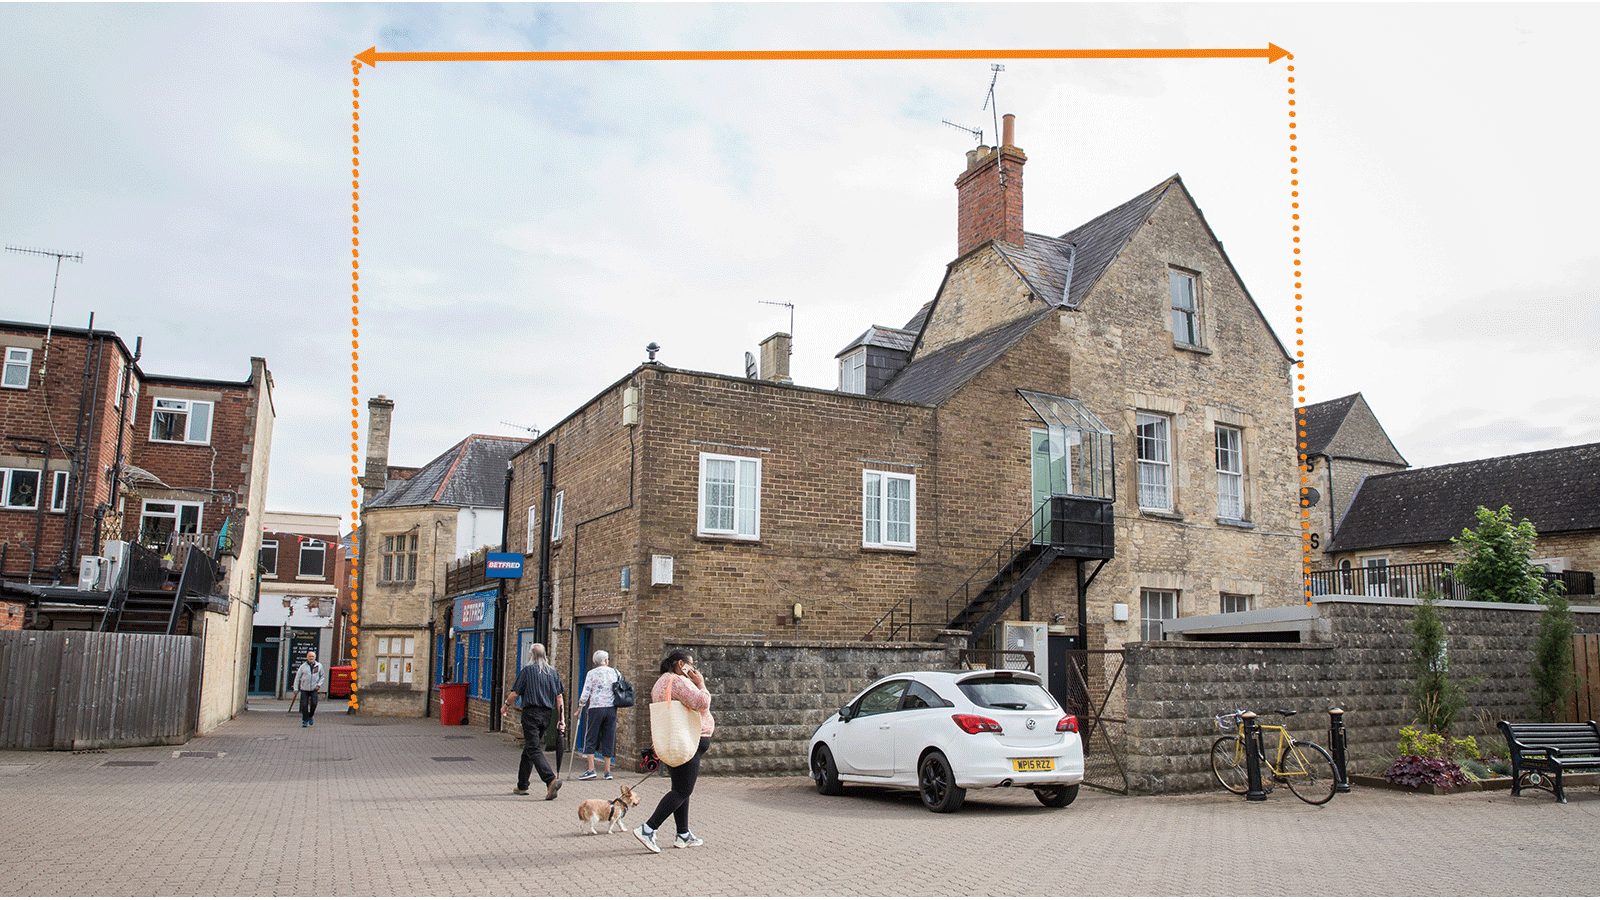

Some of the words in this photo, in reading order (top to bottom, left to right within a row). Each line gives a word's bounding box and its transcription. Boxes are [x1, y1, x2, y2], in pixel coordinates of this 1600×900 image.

[488, 561, 520, 569] BETFRED
[462, 602, 485, 622] BETFRED
[1017, 760, 1035, 769] WP15
[1036, 760, 1051, 769] RZZ
